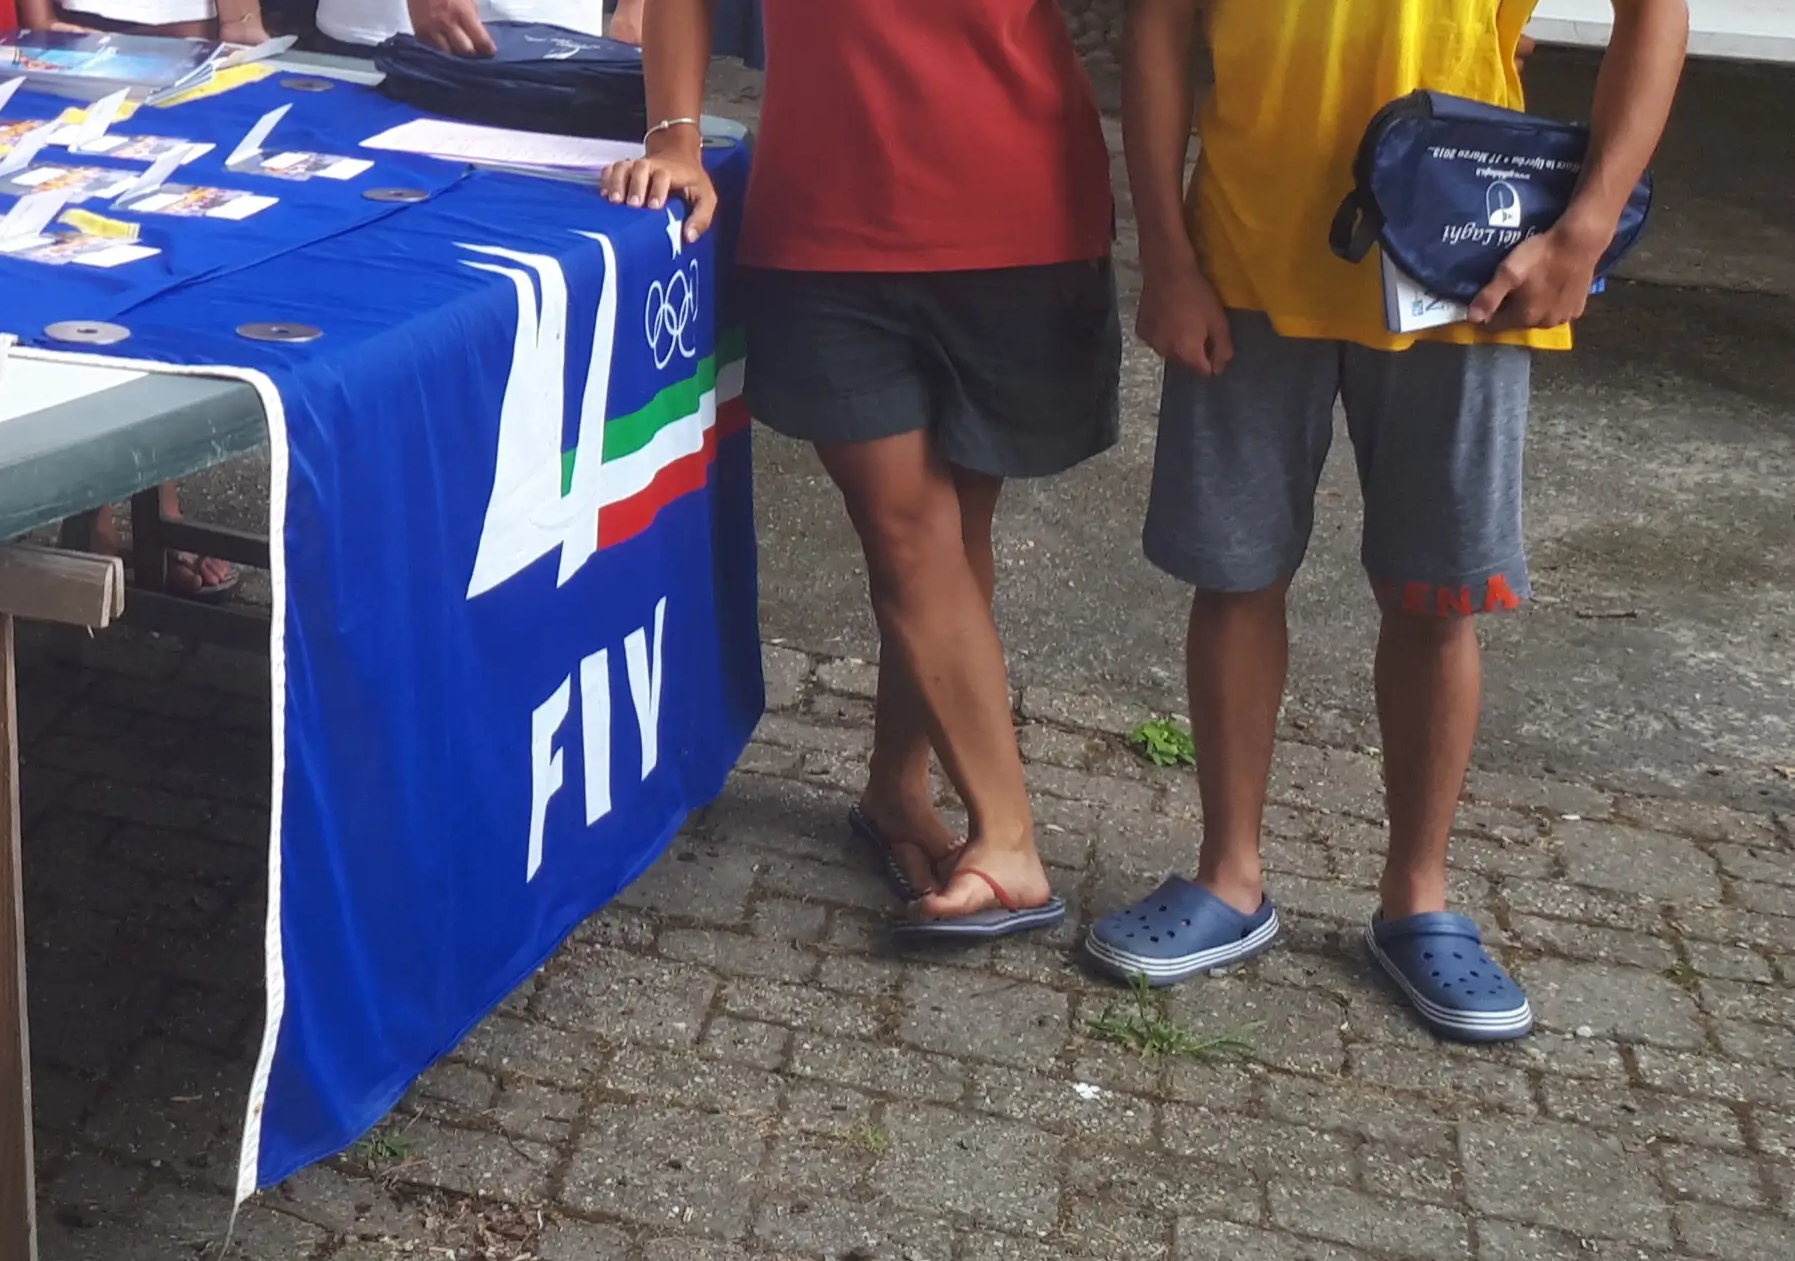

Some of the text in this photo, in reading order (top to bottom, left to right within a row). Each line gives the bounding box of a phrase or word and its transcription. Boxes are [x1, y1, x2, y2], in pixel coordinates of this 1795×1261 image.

[1457, 150, 1488, 163] Marzo
[1441, 222, 1495, 247] Laghi
[1499, 228, 1522, 248] dei
[525, 595, 667, 884] FIV
